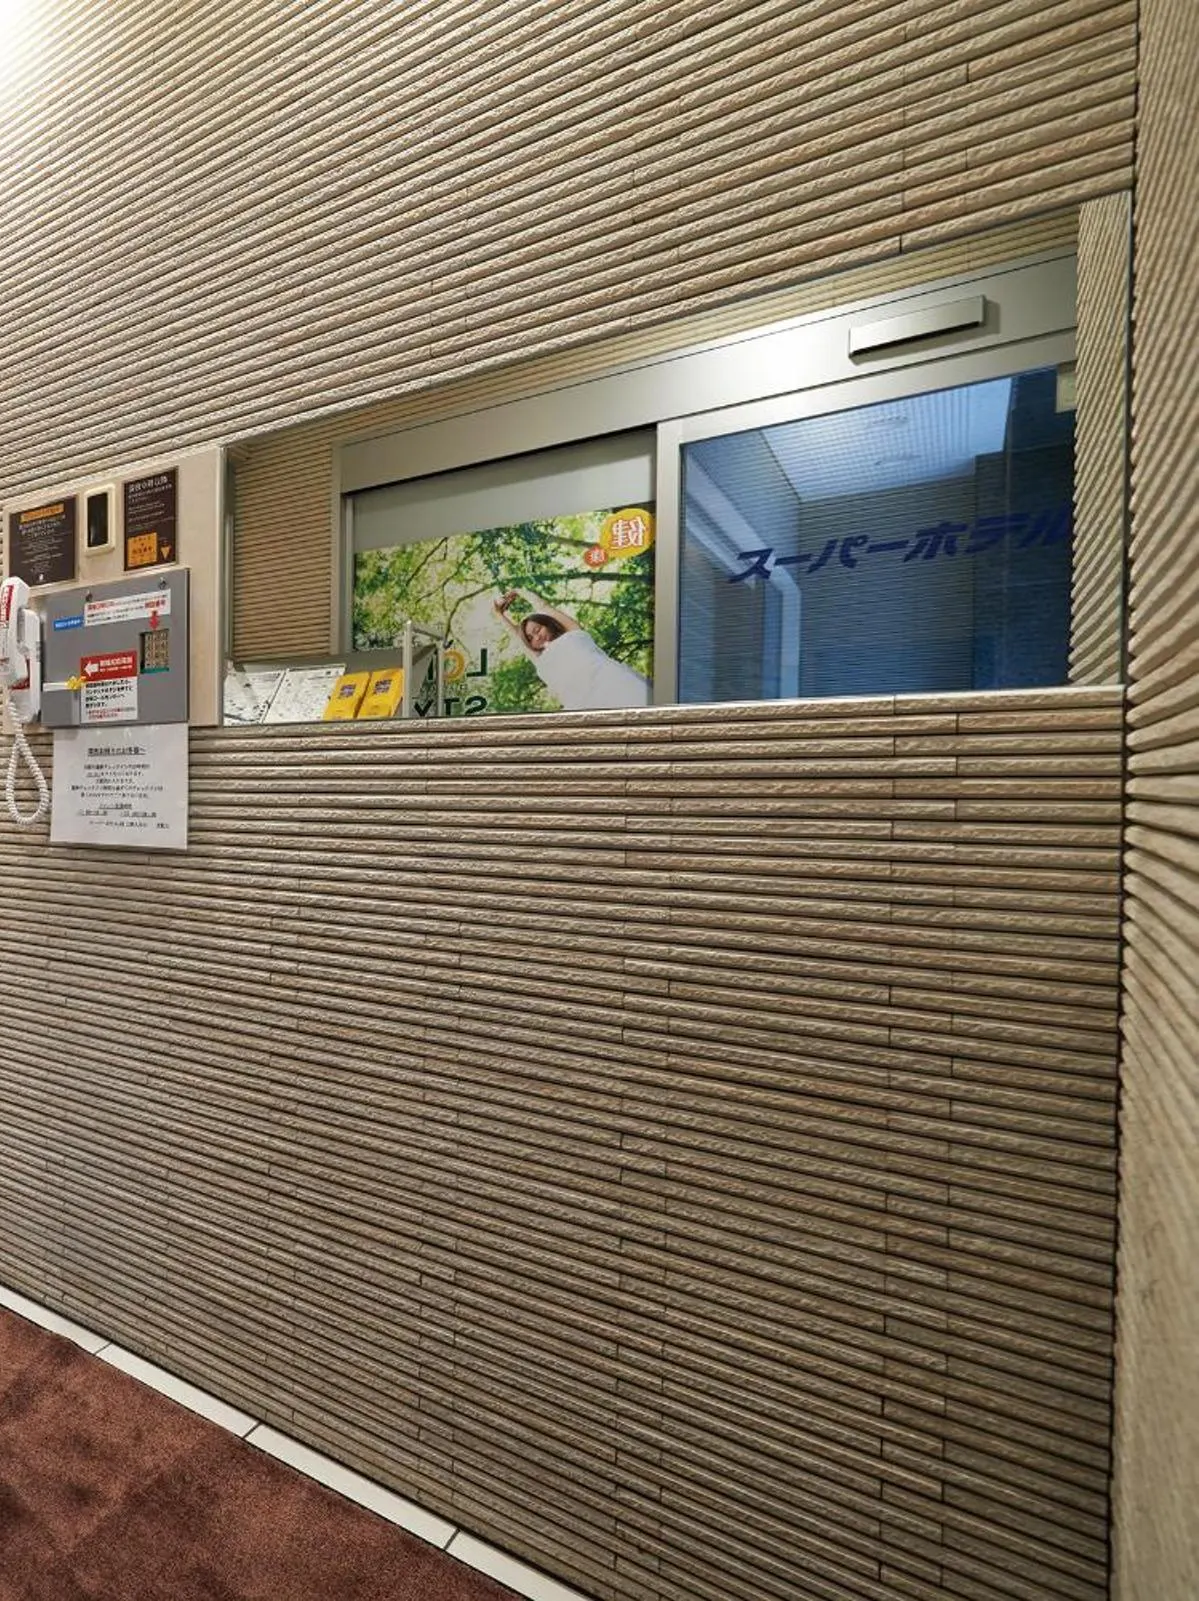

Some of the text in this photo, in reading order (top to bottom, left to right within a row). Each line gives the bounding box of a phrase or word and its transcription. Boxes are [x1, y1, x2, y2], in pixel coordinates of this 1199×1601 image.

[729, 507, 1071, 582] スーパーホテル
